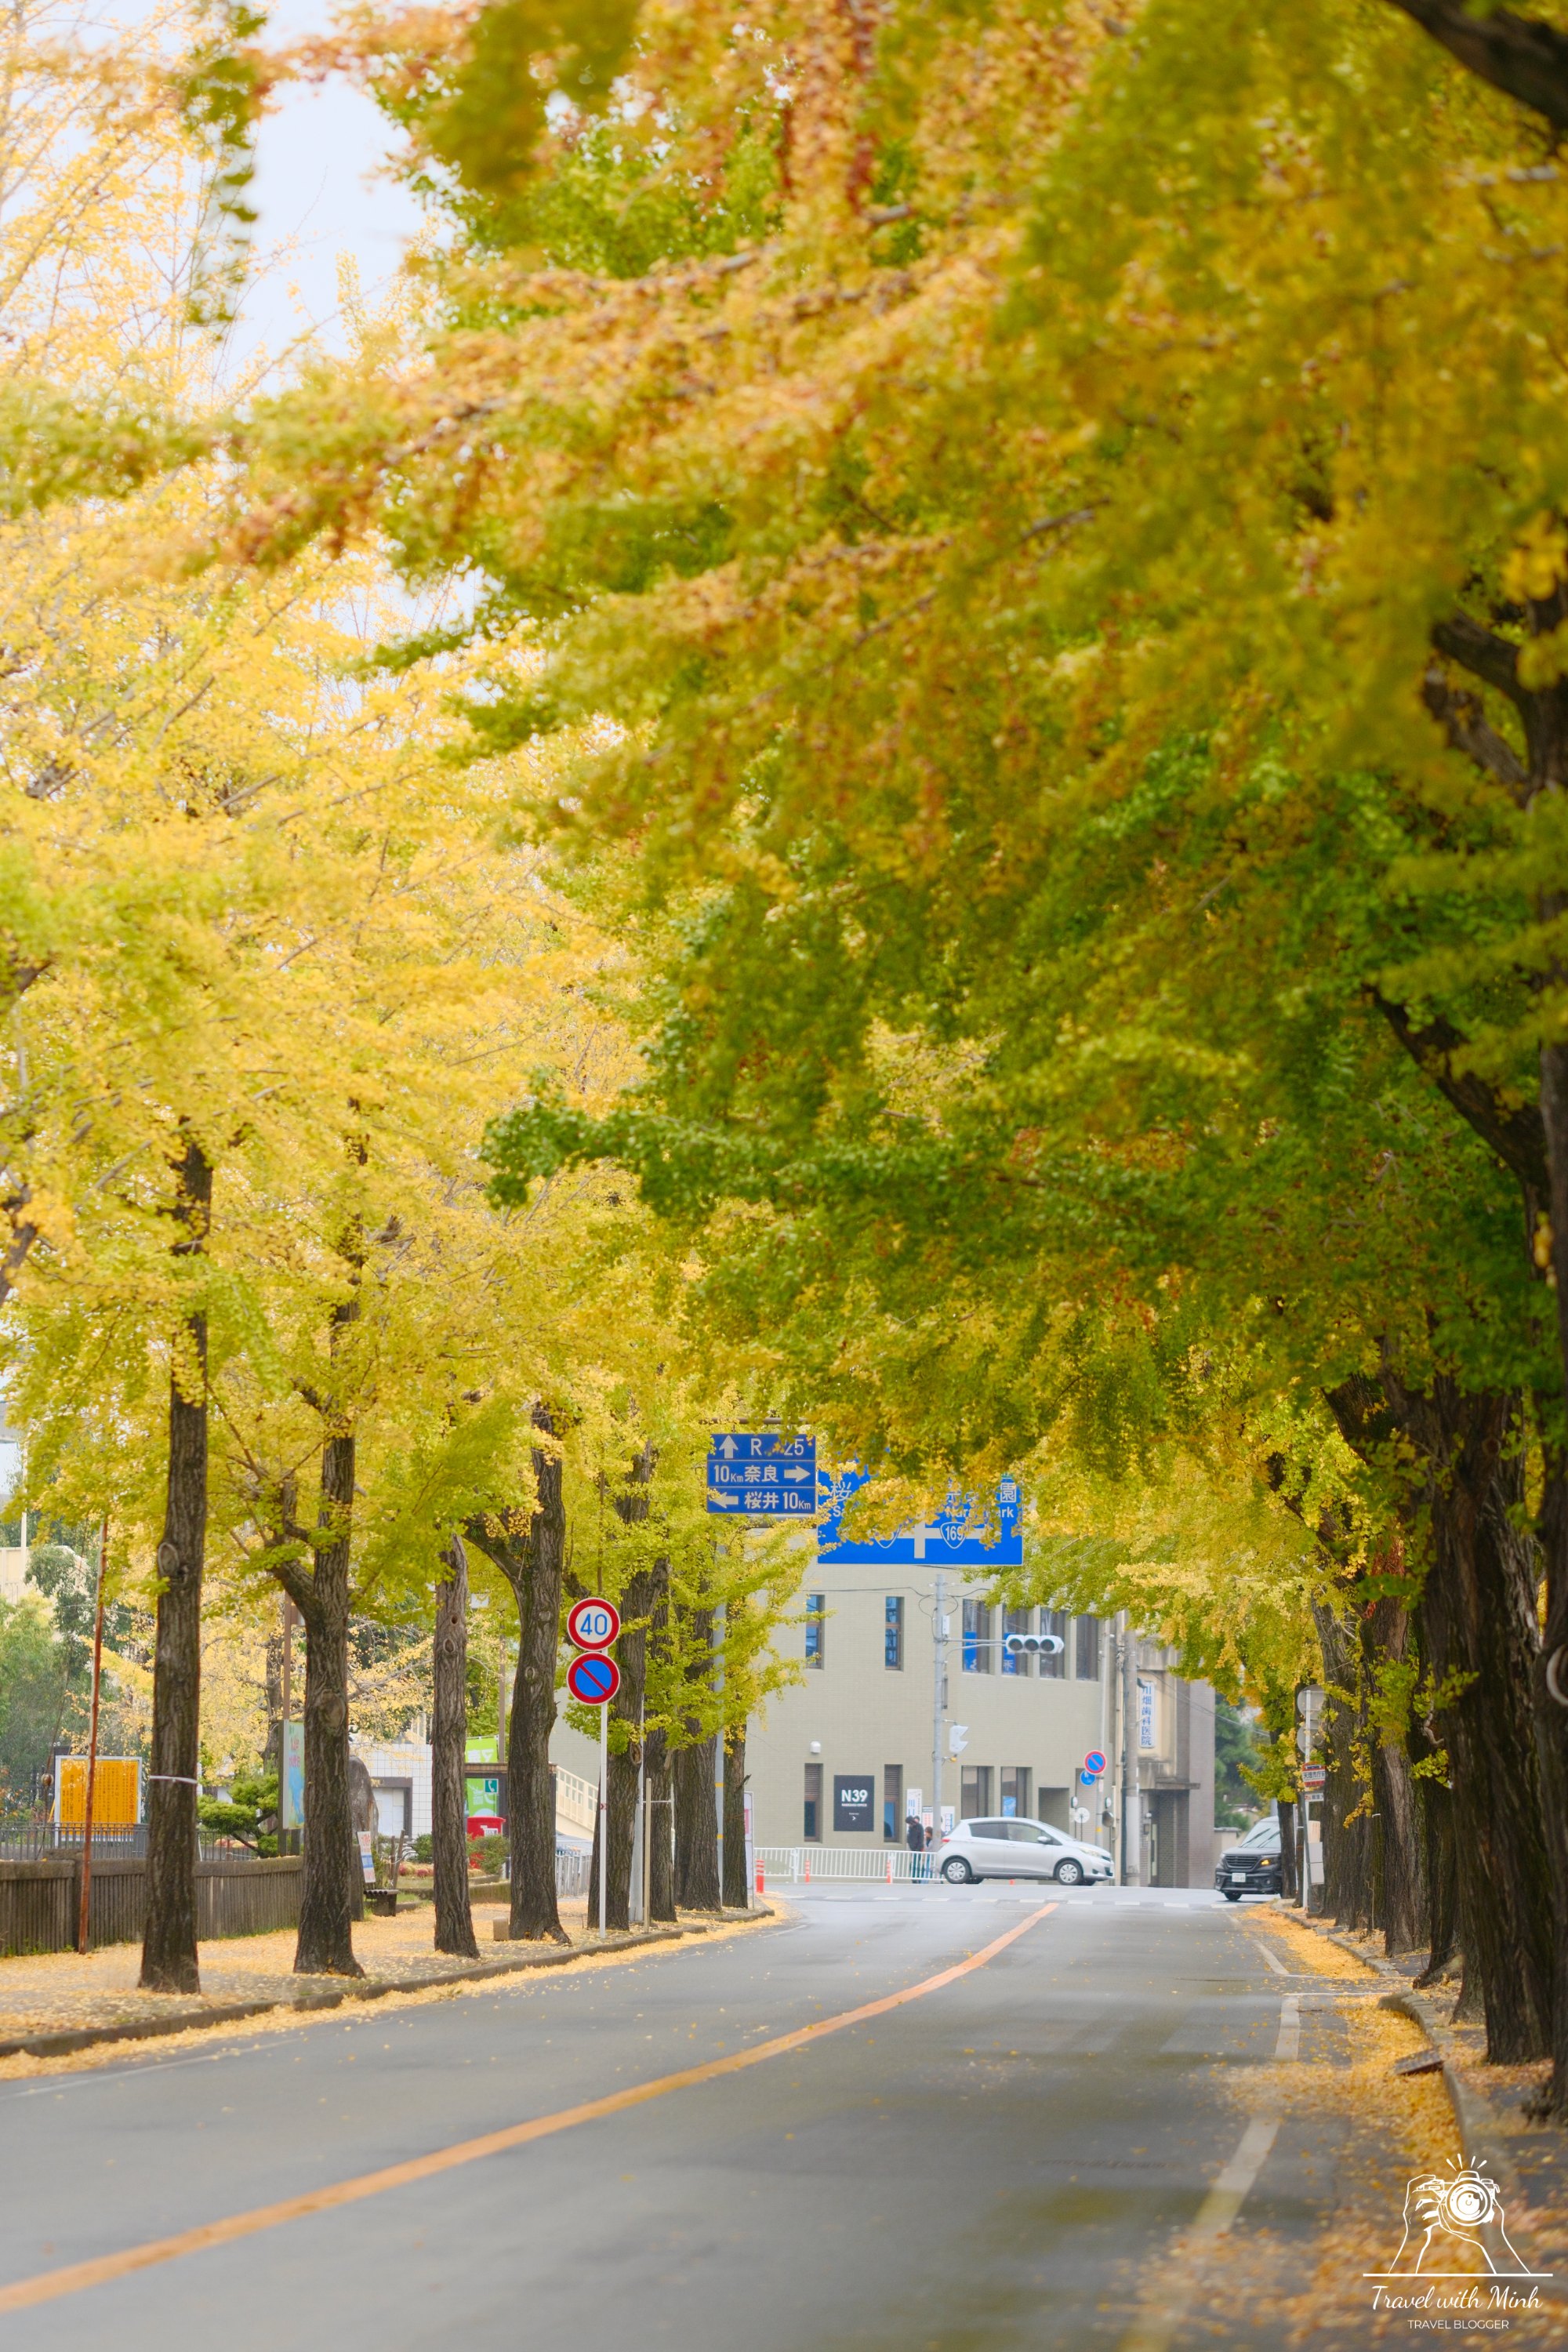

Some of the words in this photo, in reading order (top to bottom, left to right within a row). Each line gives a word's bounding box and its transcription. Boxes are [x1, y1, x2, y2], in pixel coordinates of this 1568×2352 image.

[750, 1438, 762, 1456] R
[744, 1465, 779, 1483] 奈良
[744, 1491, 779, 1509] 桜井
[580, 1613, 608, 1636] 40
[841, 1789, 868, 1802] N39
